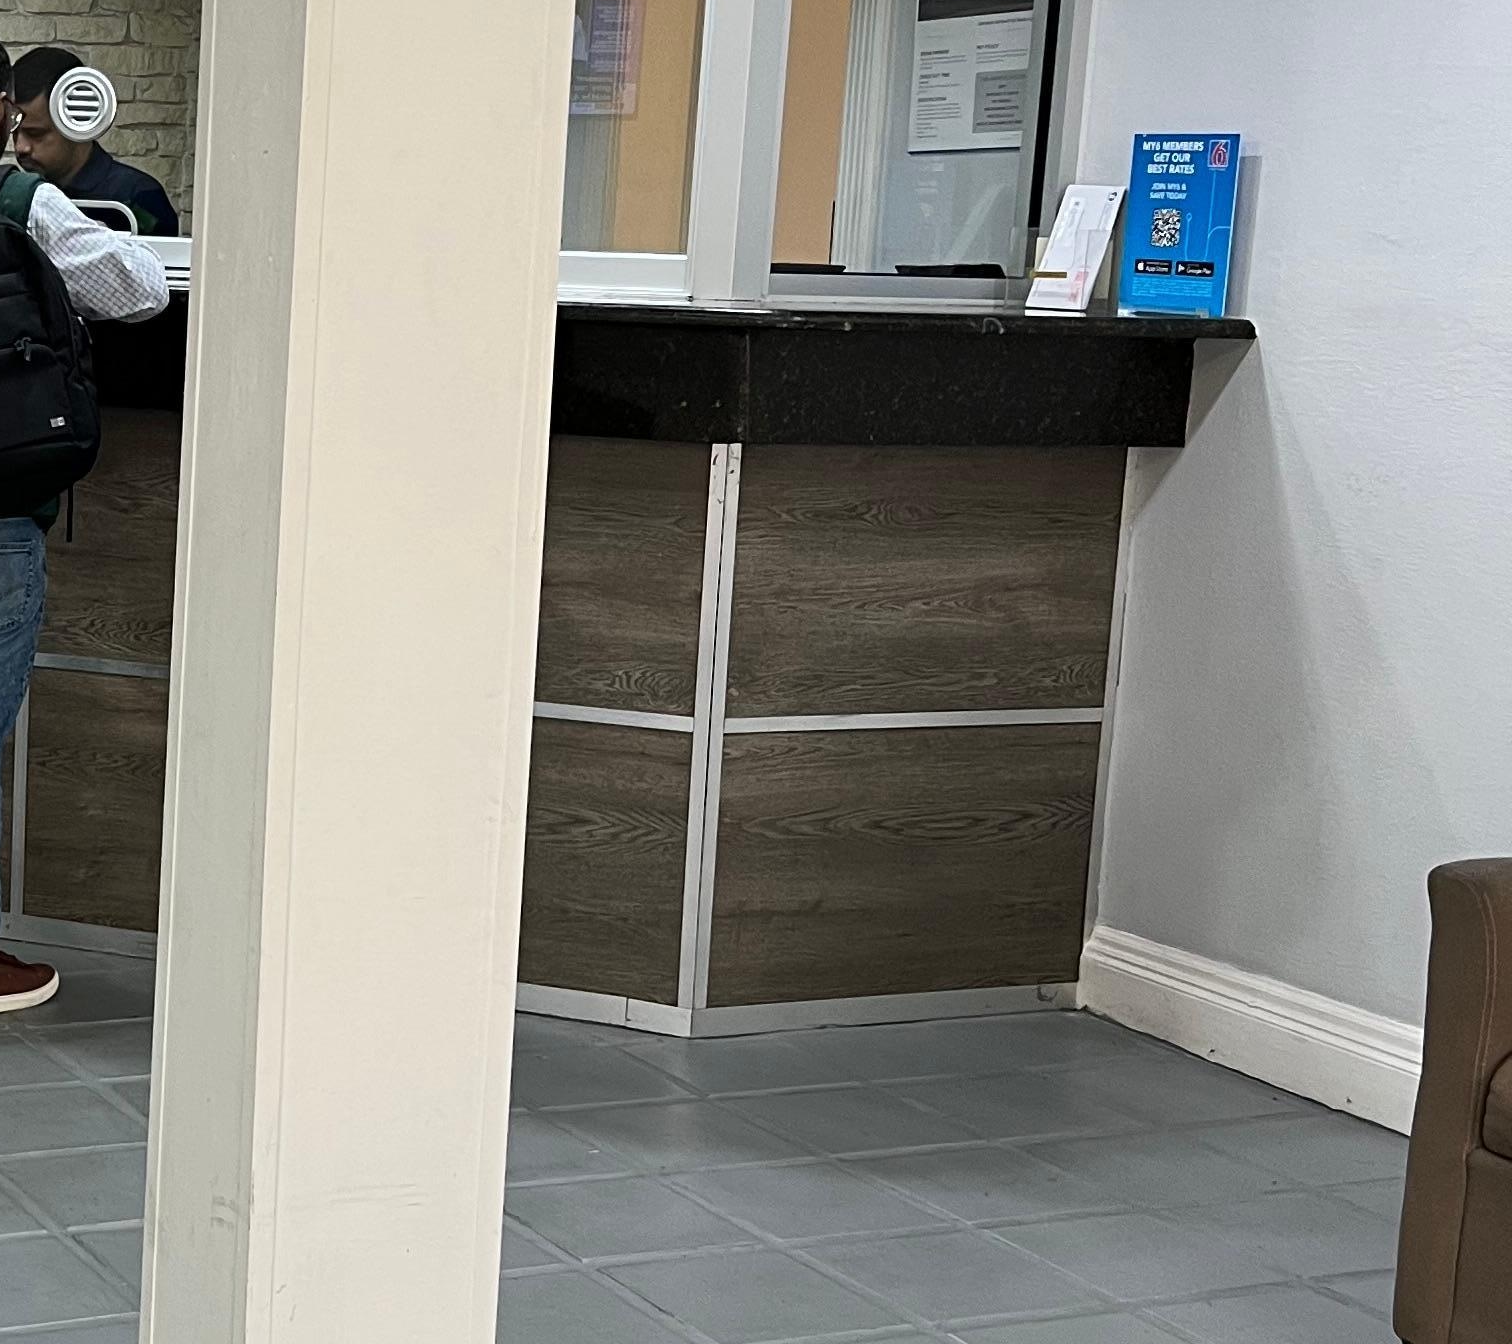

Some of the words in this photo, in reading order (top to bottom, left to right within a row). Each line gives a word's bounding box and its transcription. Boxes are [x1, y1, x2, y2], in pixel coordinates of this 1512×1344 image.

[1142, 141, 1161, 151] MY6
[1161, 141, 1205, 152] MEMBERS
[1153, 153, 1170, 163] GET
[1171, 153, 1191, 163] OUR
[1147, 164, 1168, 174] BEST
[1168, 164, 1195, 175] RATES
